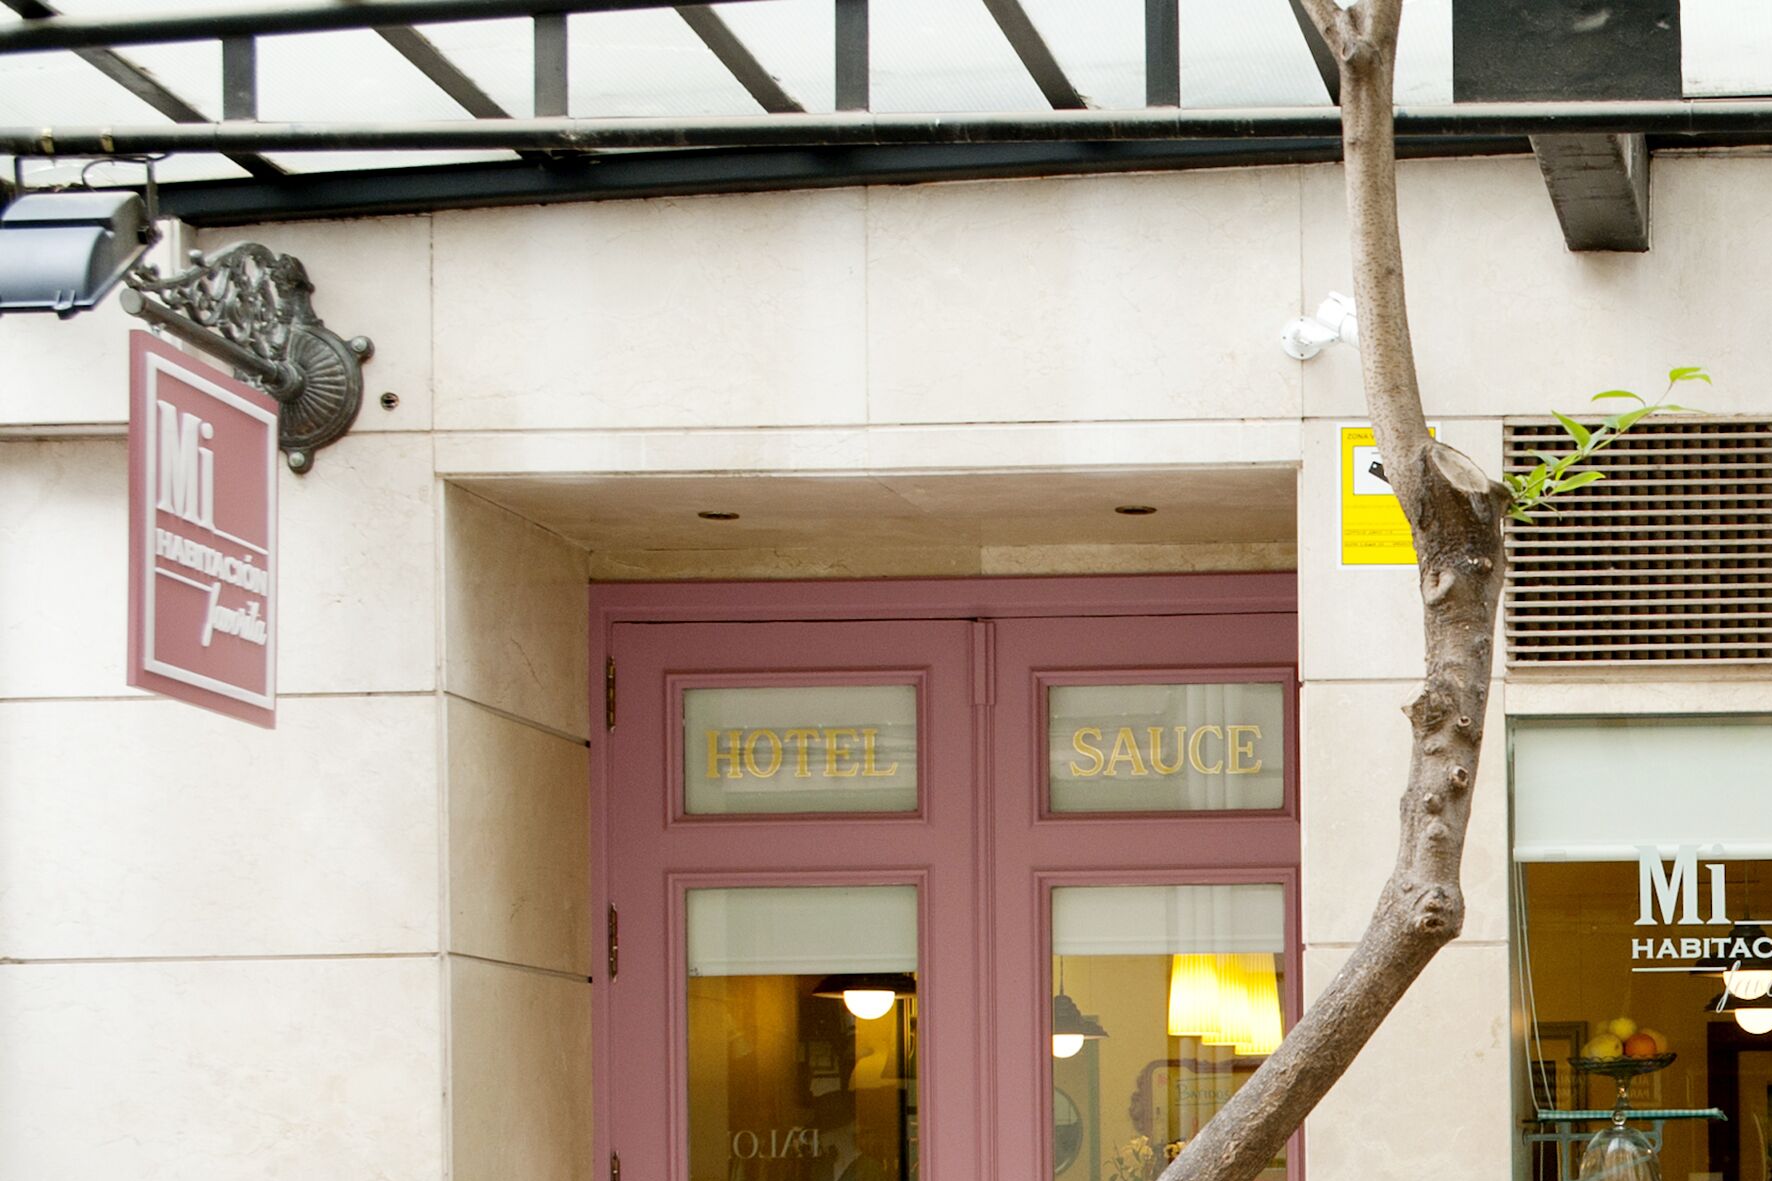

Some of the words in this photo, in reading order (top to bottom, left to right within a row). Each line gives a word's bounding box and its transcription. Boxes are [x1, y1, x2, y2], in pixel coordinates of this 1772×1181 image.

[156, 400, 215, 530] Mi
[156, 528, 268, 597] HABITACIÓN
[705, 728, 898, 778] HOTEL
[1070, 725, 1263, 776] SAUCE
[1633, 843, 1732, 925] Mi
